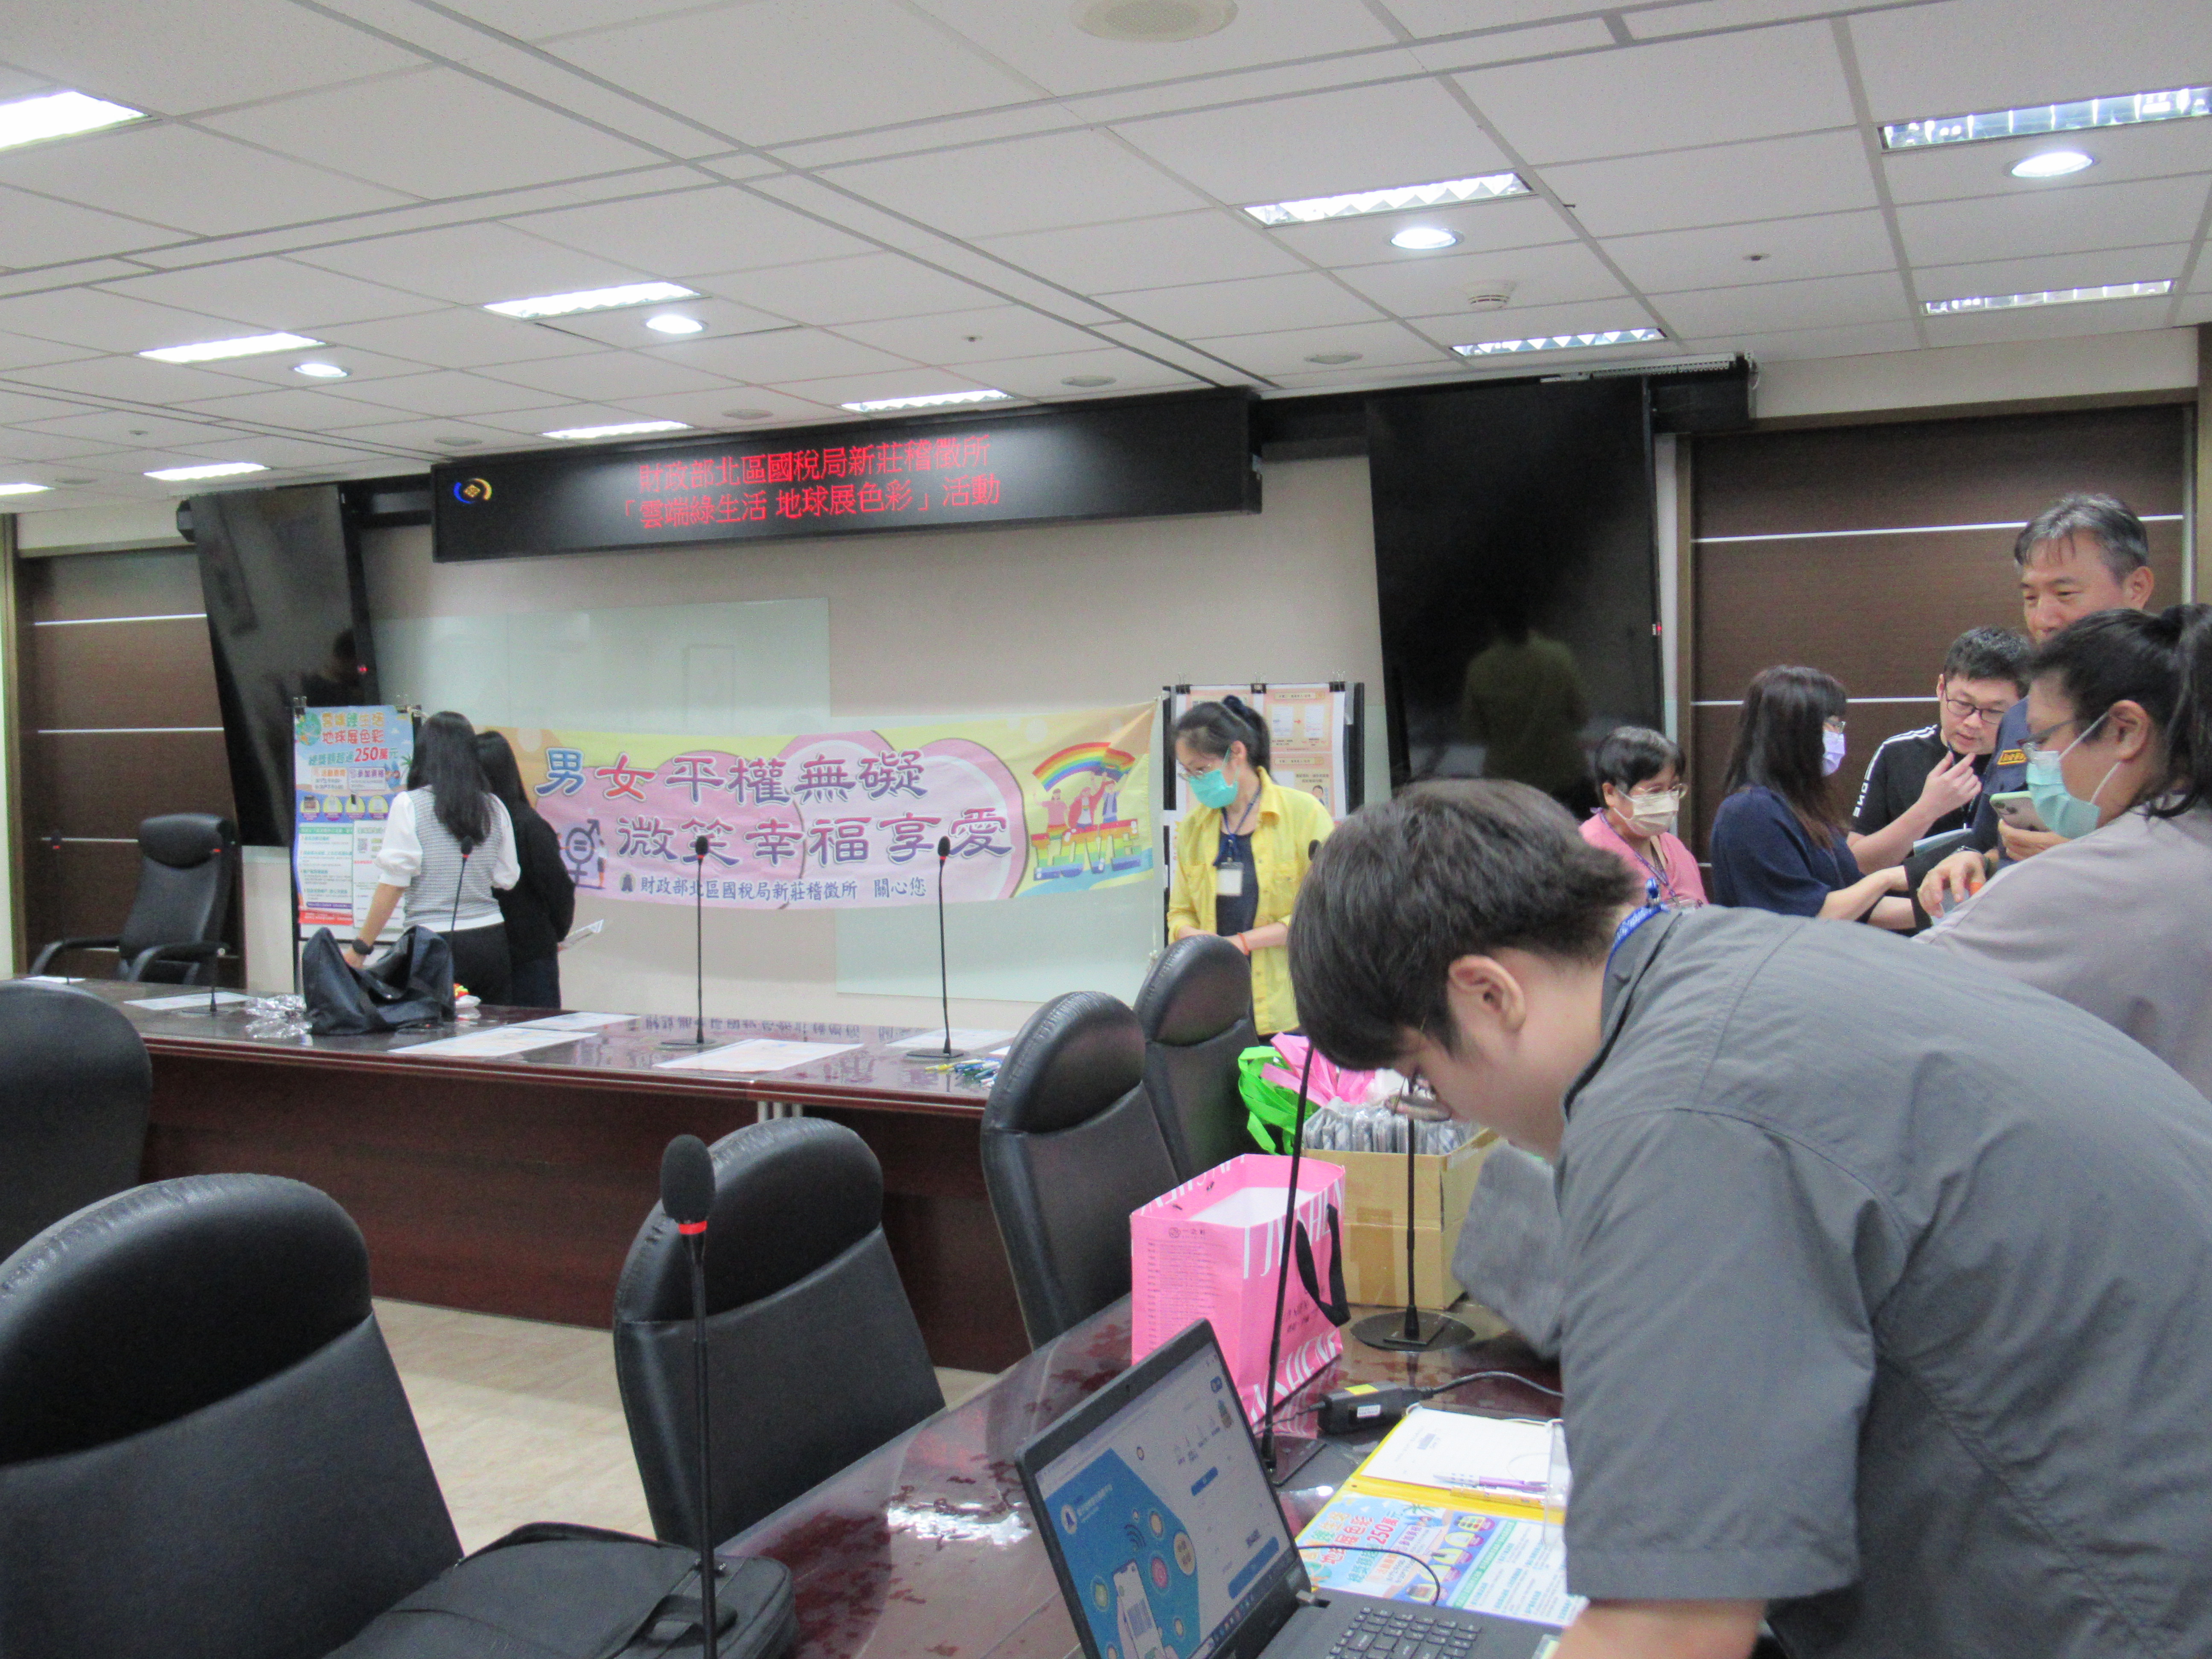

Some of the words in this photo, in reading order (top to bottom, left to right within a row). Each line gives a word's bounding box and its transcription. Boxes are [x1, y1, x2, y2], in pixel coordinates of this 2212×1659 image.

[535, 747, 928, 806] 男女平權無礙
[617, 807, 1013, 867] 微笑幸福享愛
[1031, 818, 1142, 881] LOVE
